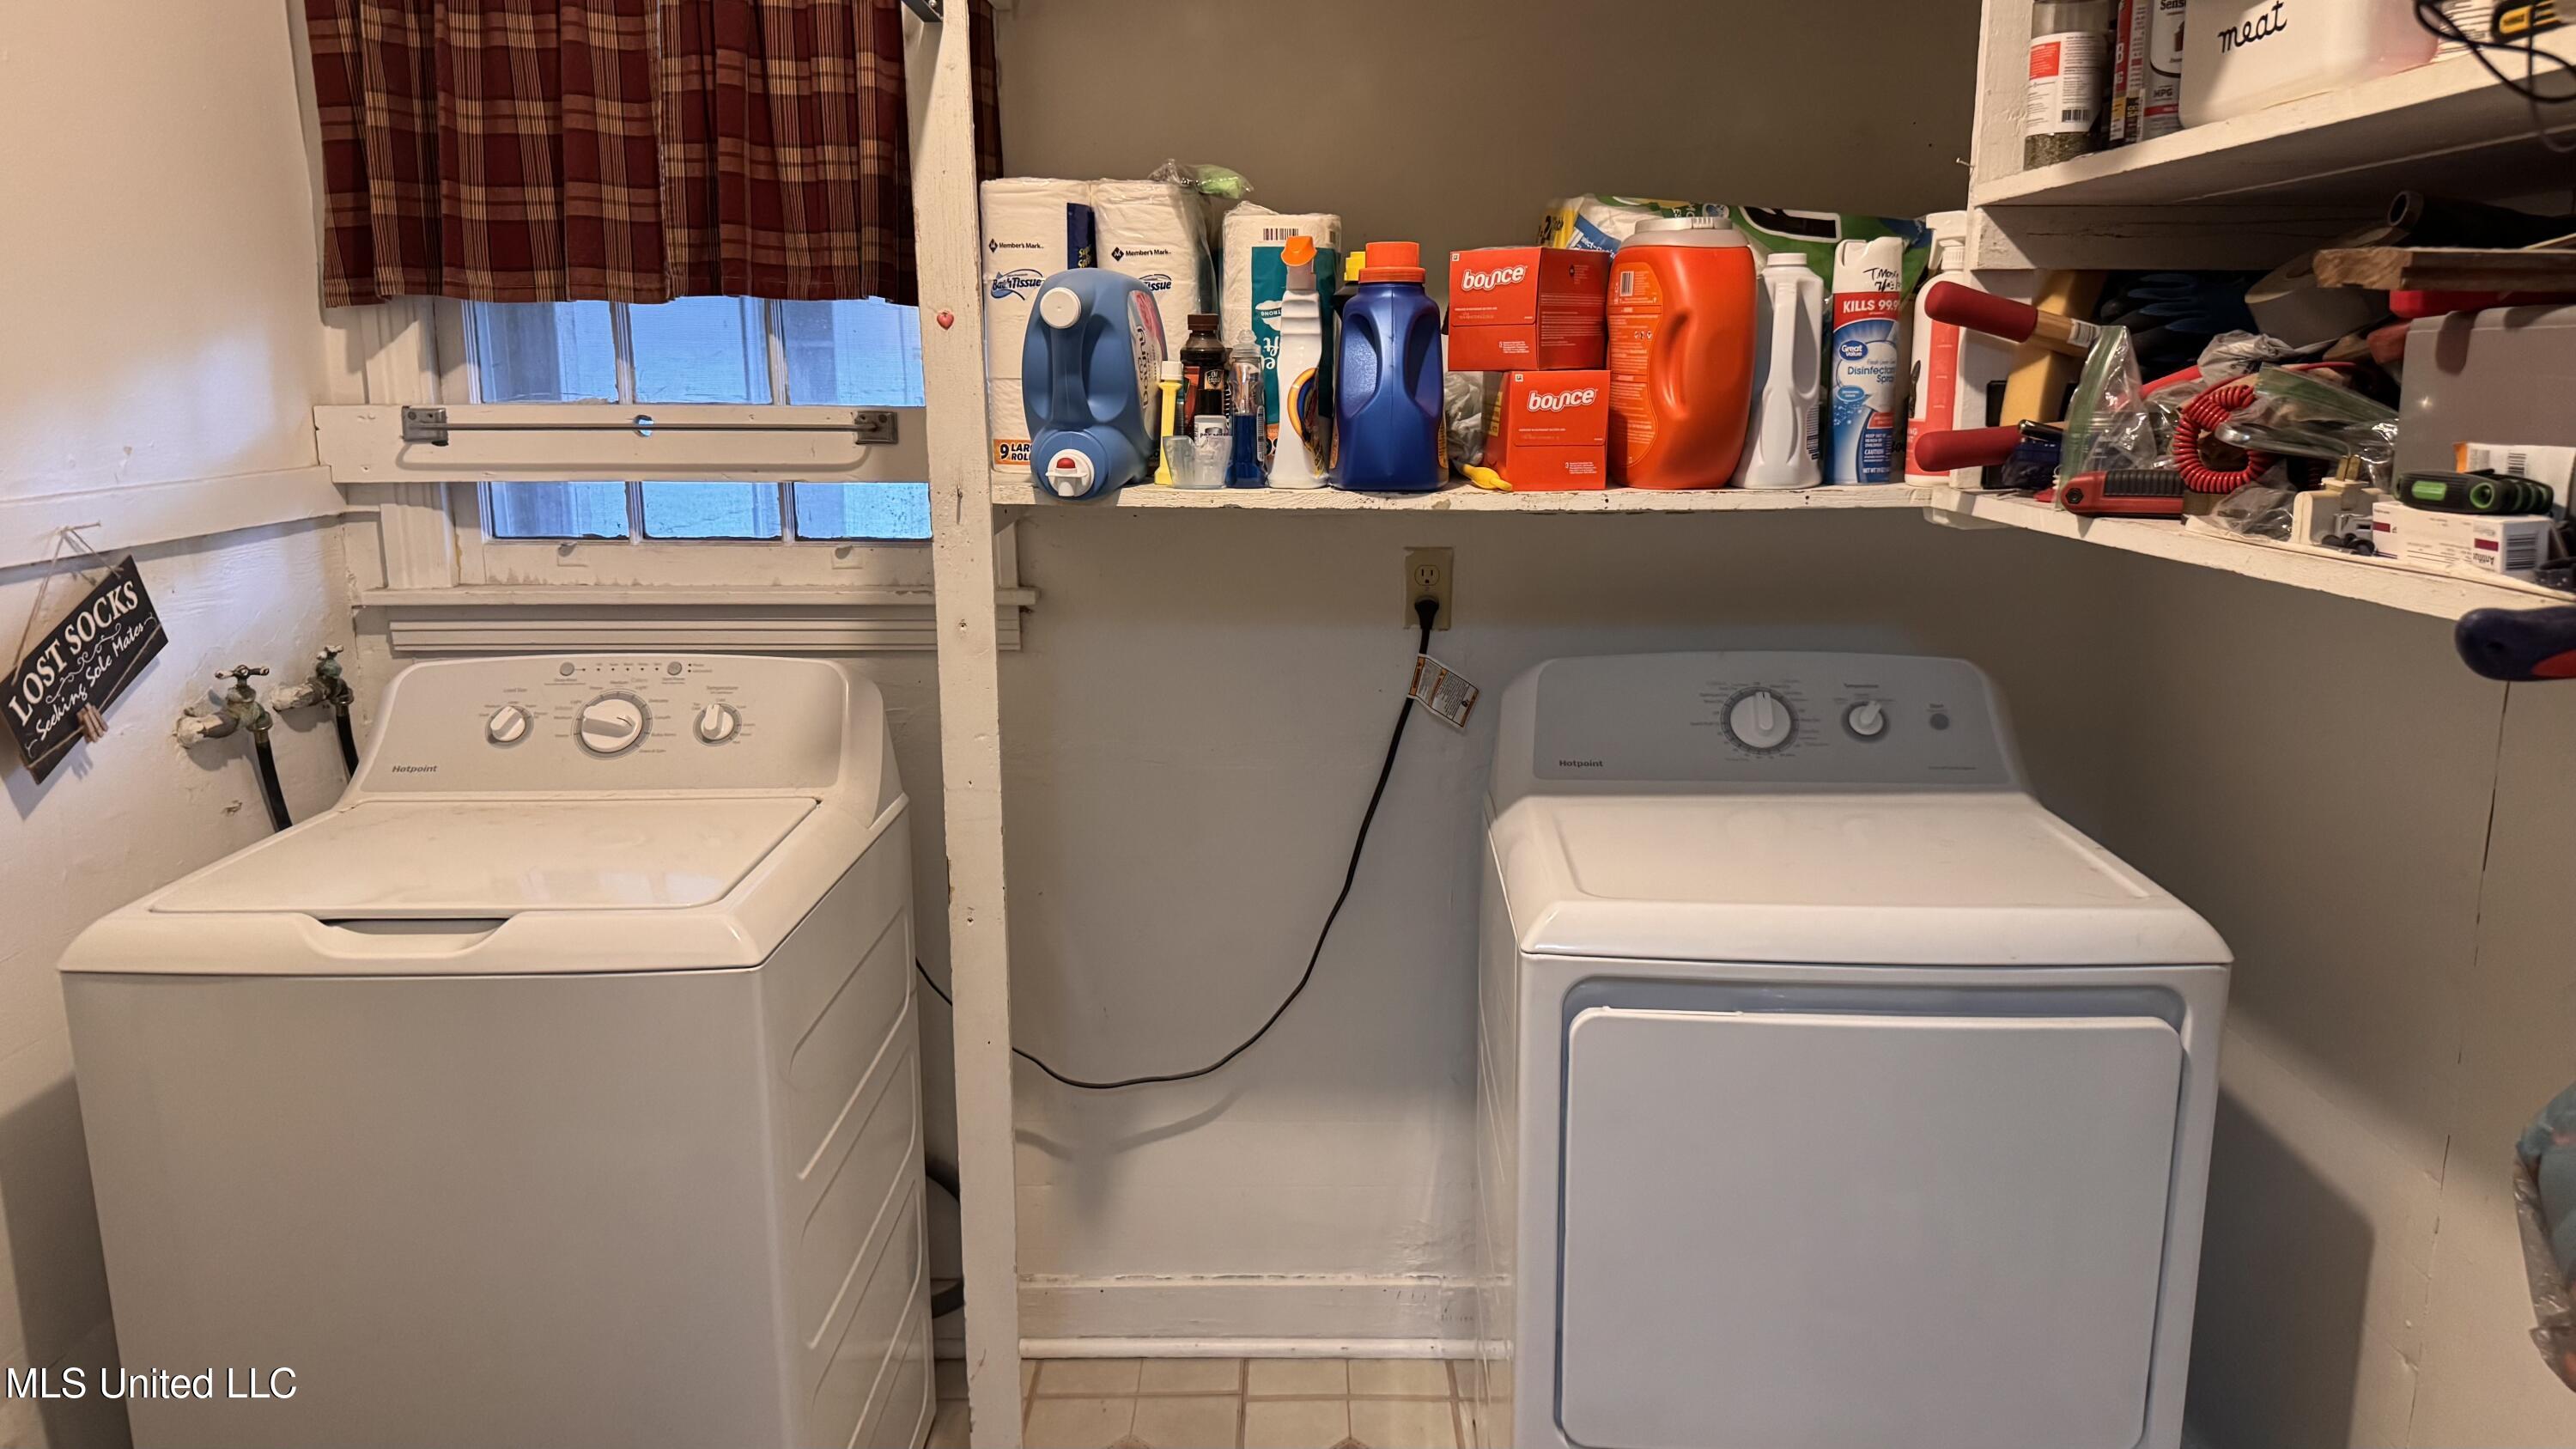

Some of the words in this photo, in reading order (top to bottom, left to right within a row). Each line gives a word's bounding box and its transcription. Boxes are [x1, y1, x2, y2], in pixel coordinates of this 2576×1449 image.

[2218, 0, 2287, 53] meat
[1012, 277, 1042, 289] Tissue
[1461, 265, 1526, 290] bounce
[1843, 300, 1875, 314] KILLS
[1878, 298, 1900, 312] 99.9
[1841, 344, 1862, 353] Great
[1136, 327, 1149, 408] Downy
[1847, 366, 1896, 375] Disinfectan
[1527, 387, 1596, 412] bounce
[999, 444, 1010, 460] 9
[1011, 444, 1032, 453] LAR
[9, 639, 67, 727] LOST
[64, 580, 138, 654] SOCKS
[35, 683, 88, 740] Seeking
[86, 654, 112, 686] Sole
[112, 623, 143, 657] Mates
[392, 764, 437, 773] Hotpoint
[1558, 759, 1603, 768] Hotpoint
